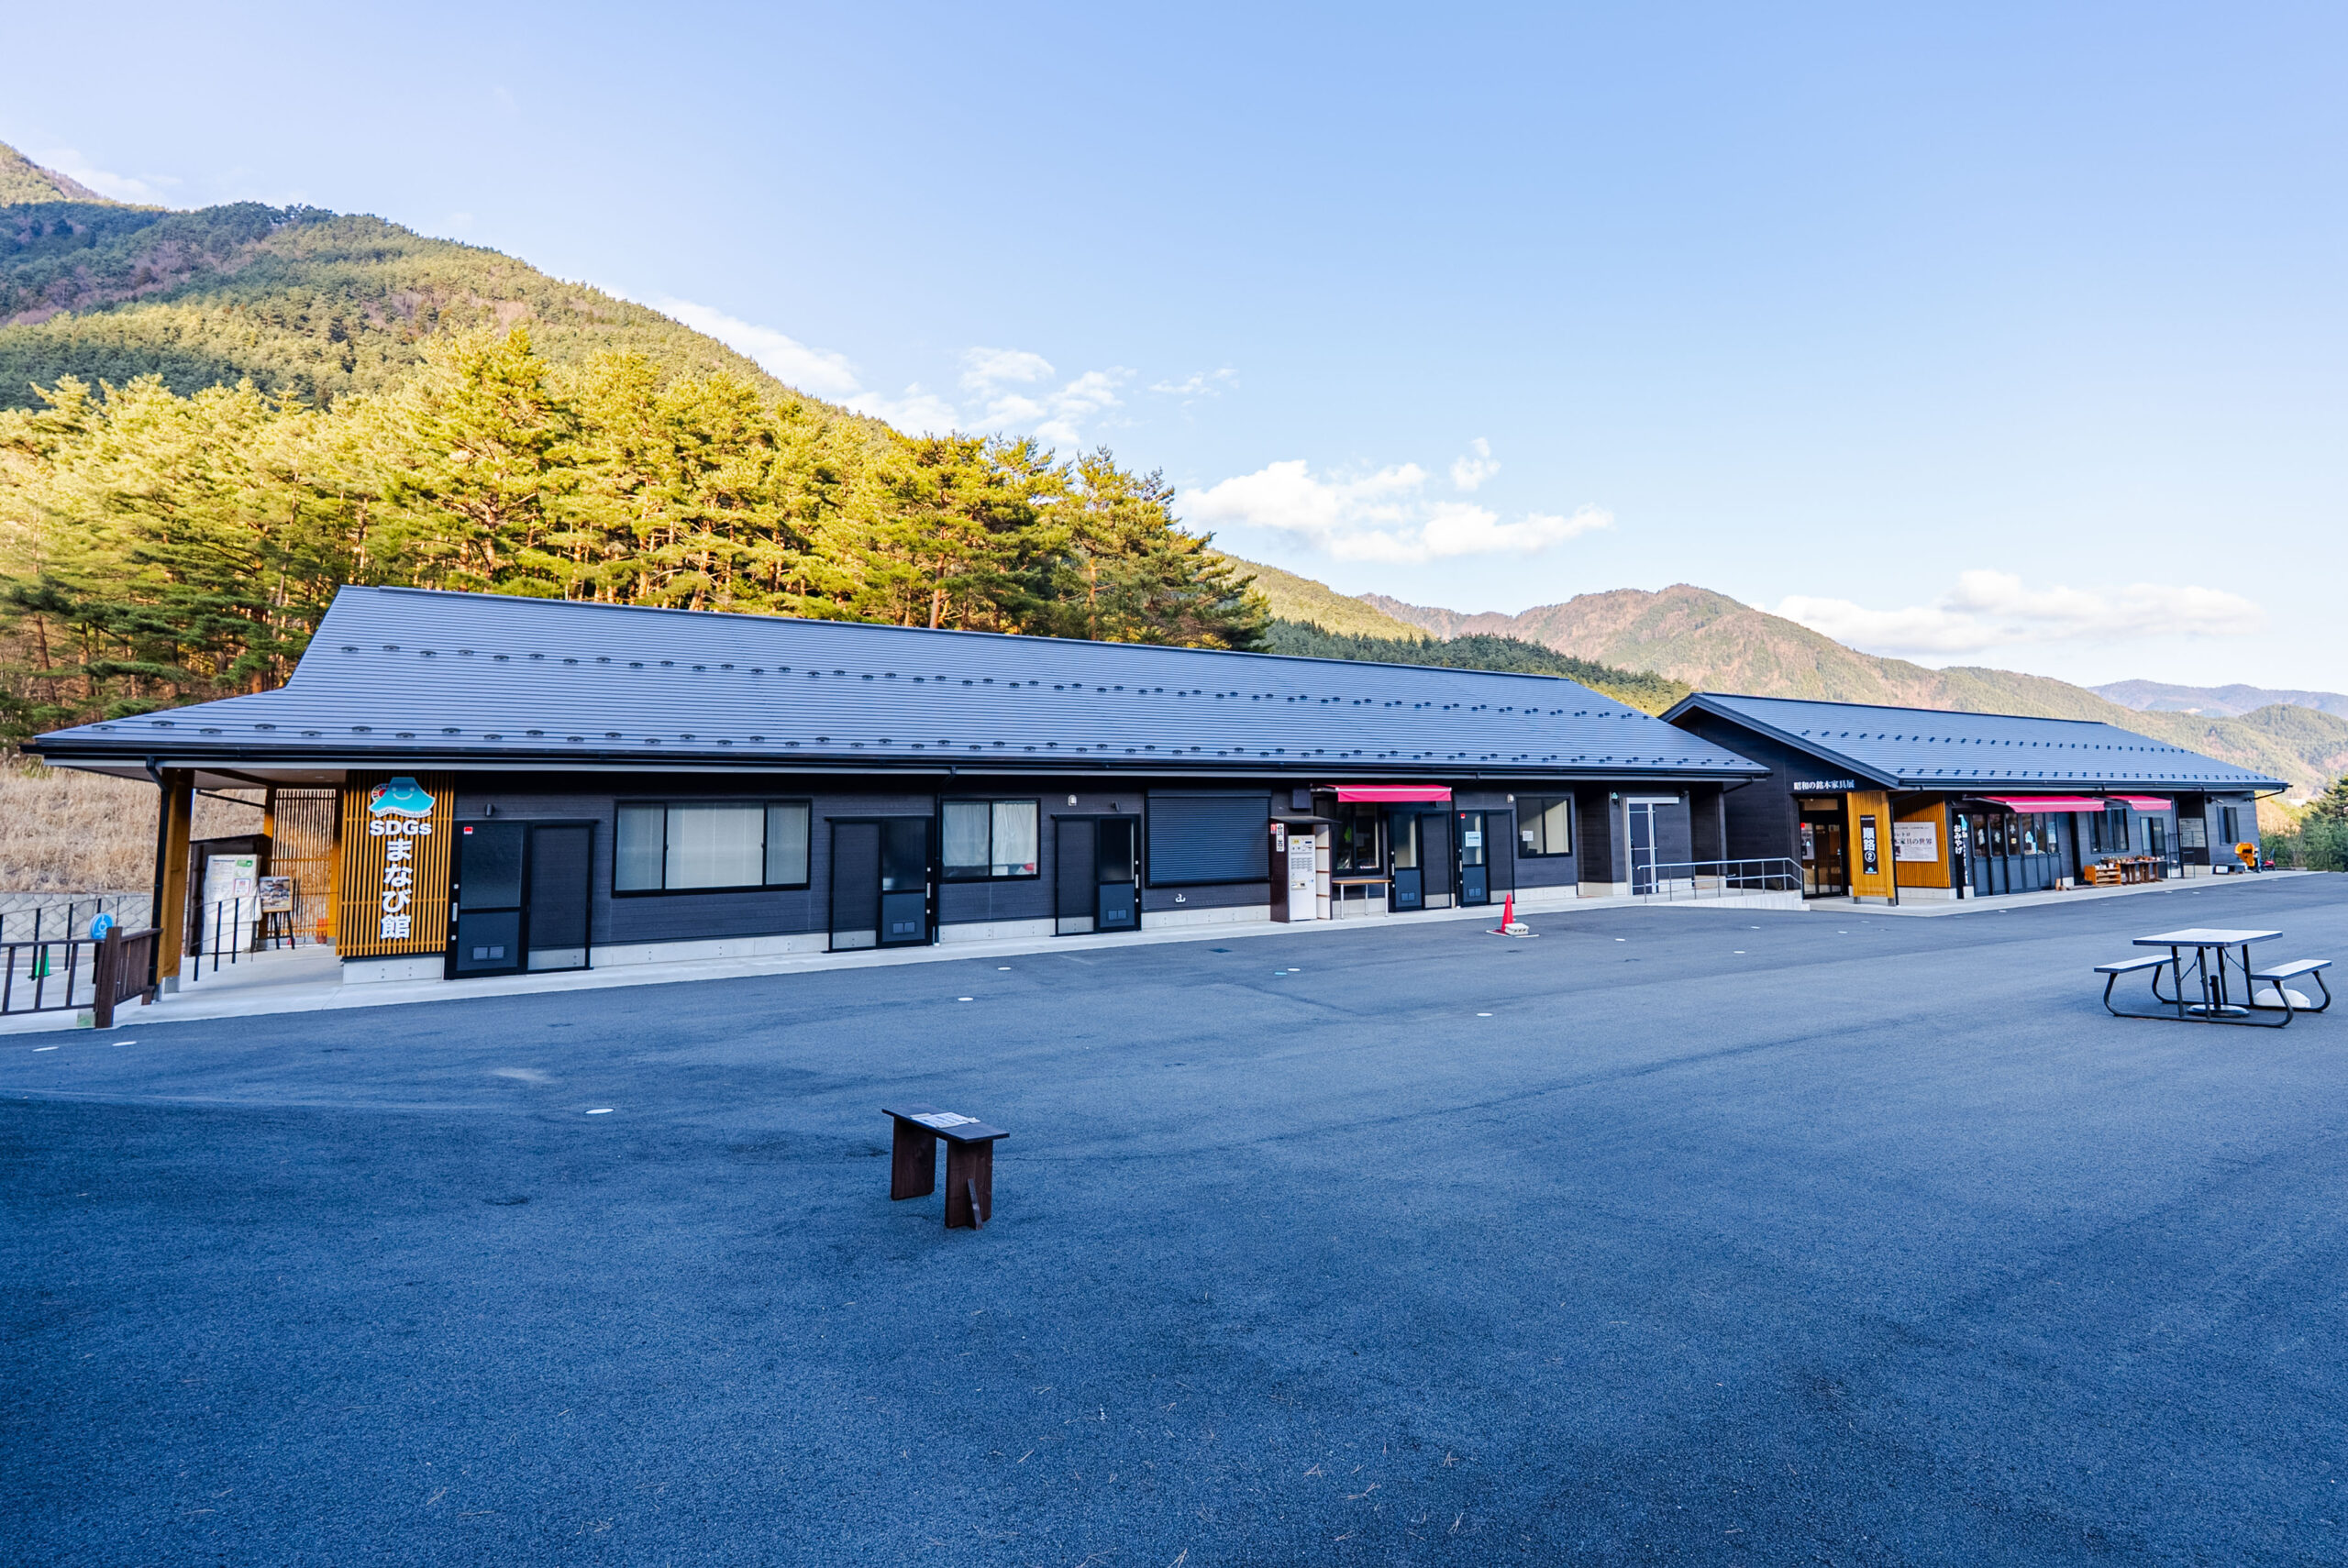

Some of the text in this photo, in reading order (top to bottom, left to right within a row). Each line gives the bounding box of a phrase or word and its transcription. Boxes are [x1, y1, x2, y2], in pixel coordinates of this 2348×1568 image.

[1793, 779, 1855, 790] 昭和の銘木家具展
[370, 819, 432, 836] SDGs
[1954, 824, 1963, 855] おみやげ
[381, 838, 413, 939] まなび館
